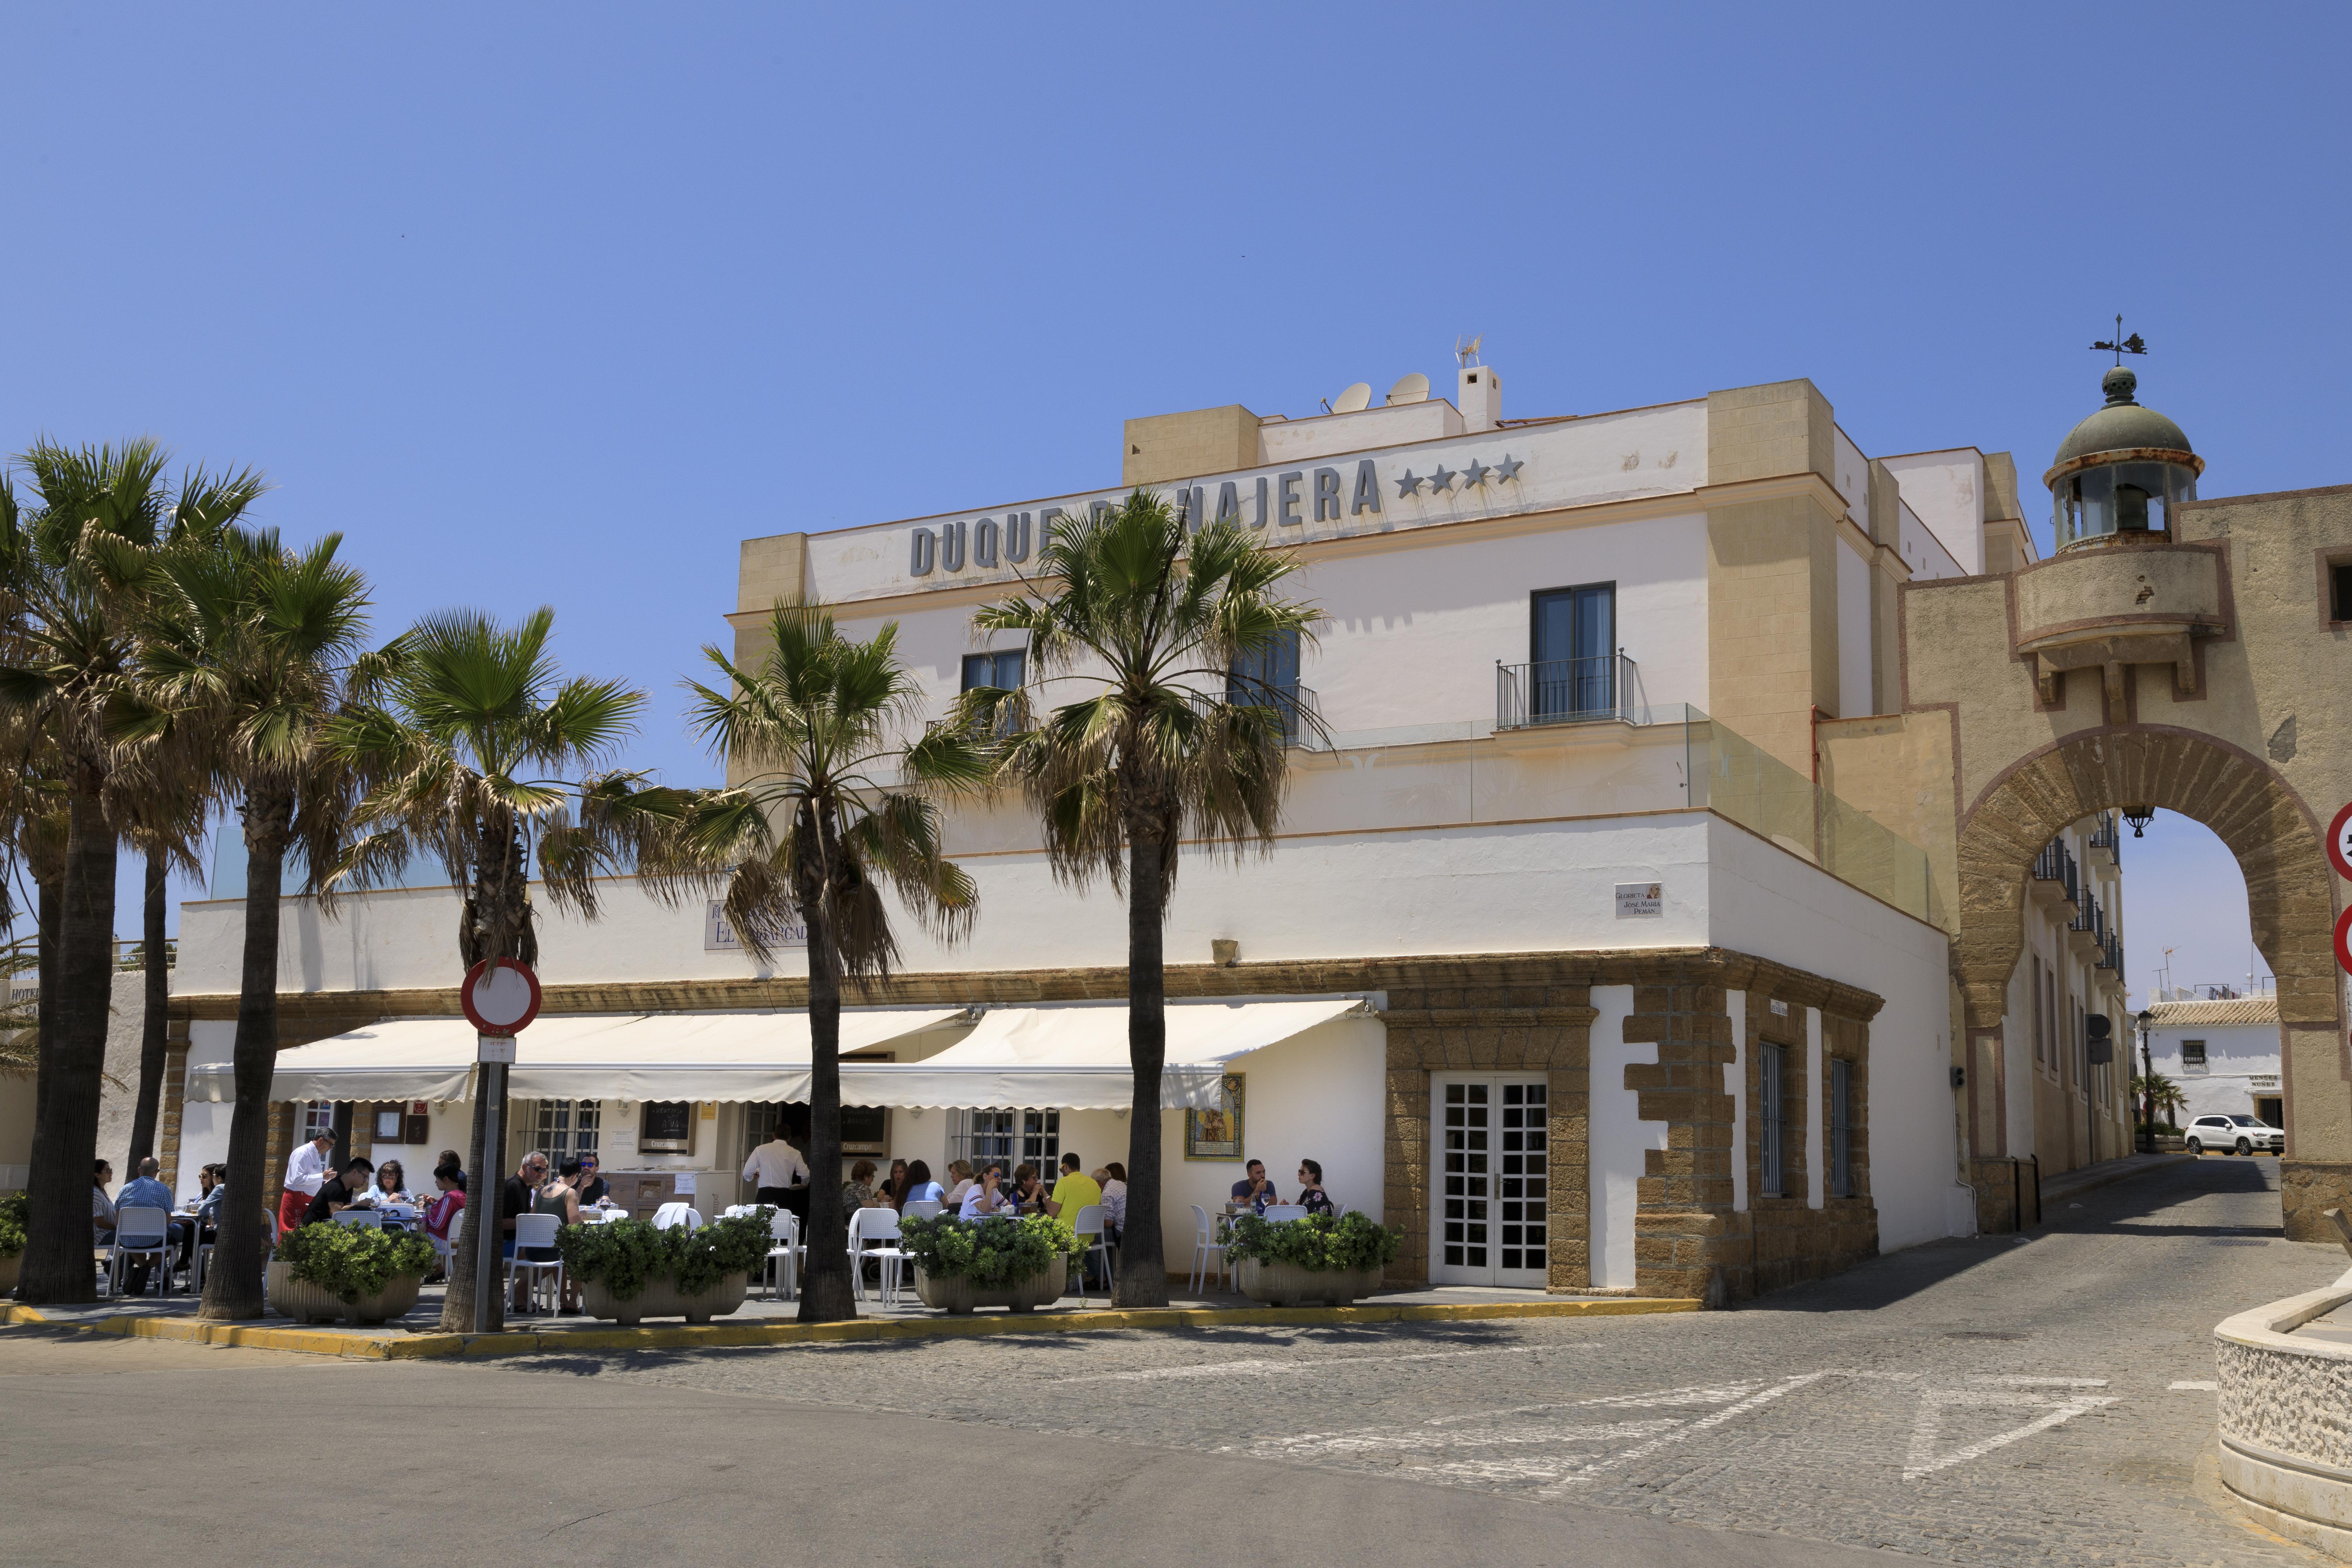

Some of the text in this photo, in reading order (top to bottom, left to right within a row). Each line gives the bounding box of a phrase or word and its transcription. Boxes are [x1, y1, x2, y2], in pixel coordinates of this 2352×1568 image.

[910, 507, 1063, 577] DUQUE
[1177, 459, 1381, 533] NAJERA
[651, 1140, 677, 1148] Cruzcampo
[843, 1143, 871, 1151] Cruzcampo
